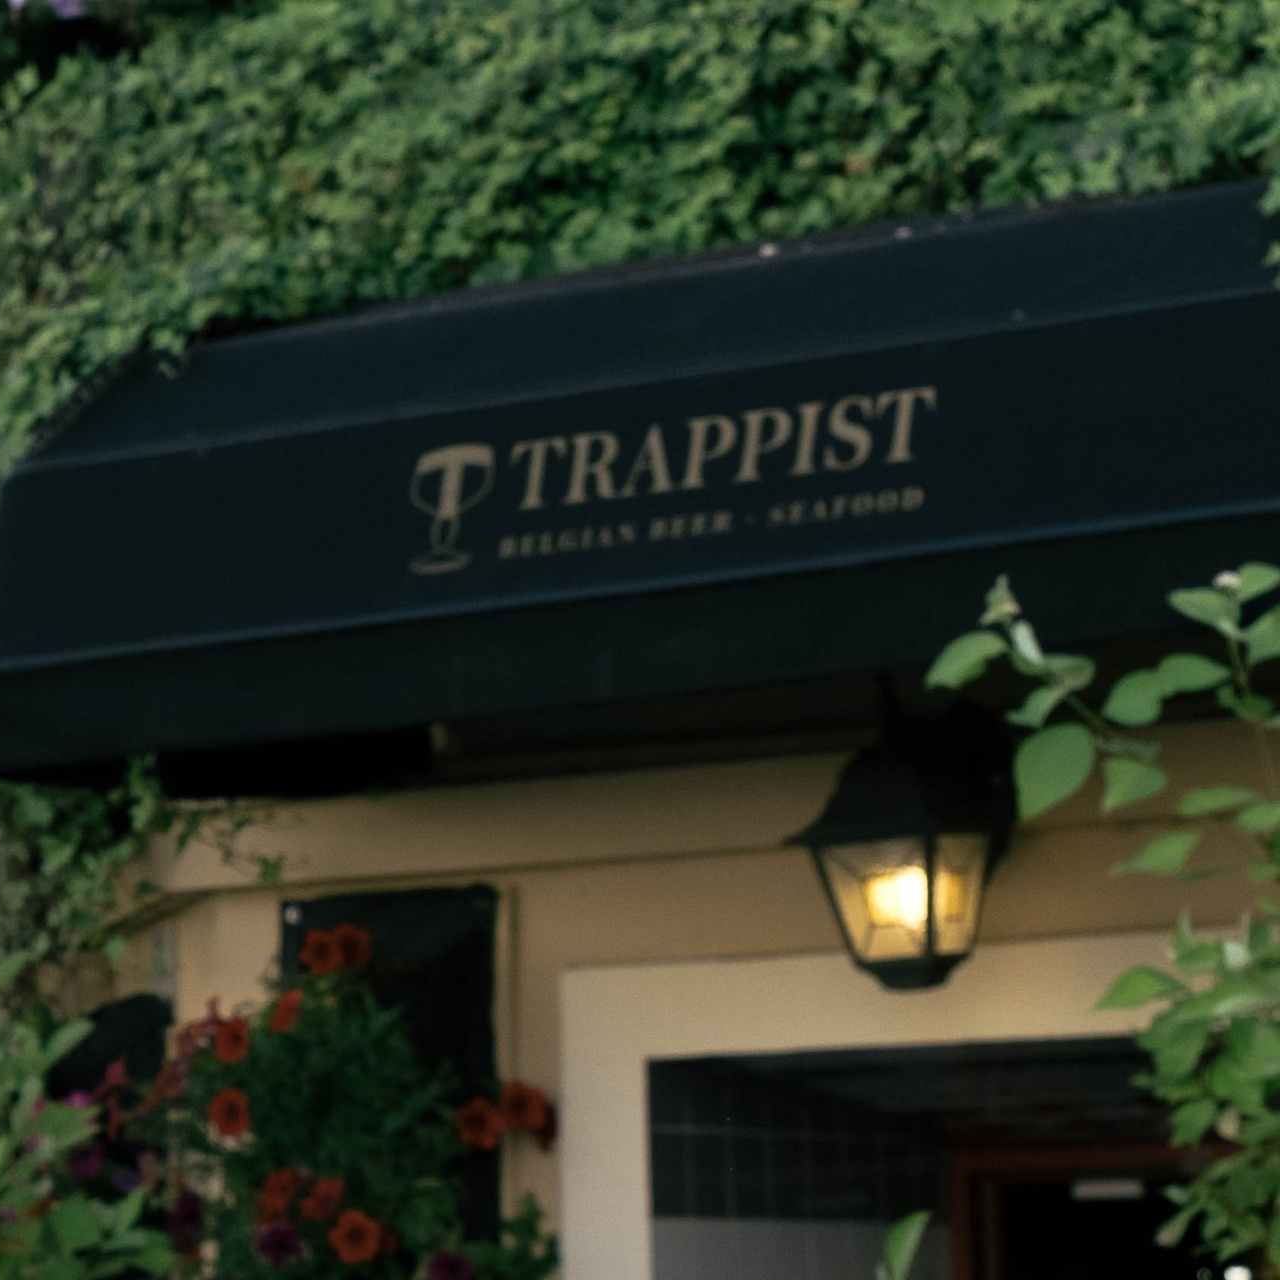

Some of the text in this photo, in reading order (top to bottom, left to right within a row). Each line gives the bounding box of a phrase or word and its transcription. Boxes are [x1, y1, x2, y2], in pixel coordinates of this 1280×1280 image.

[509, 386, 937, 510] TRAPPIST
[499, 487, 926, 560] BELGIAN BEER SEAFOOD
